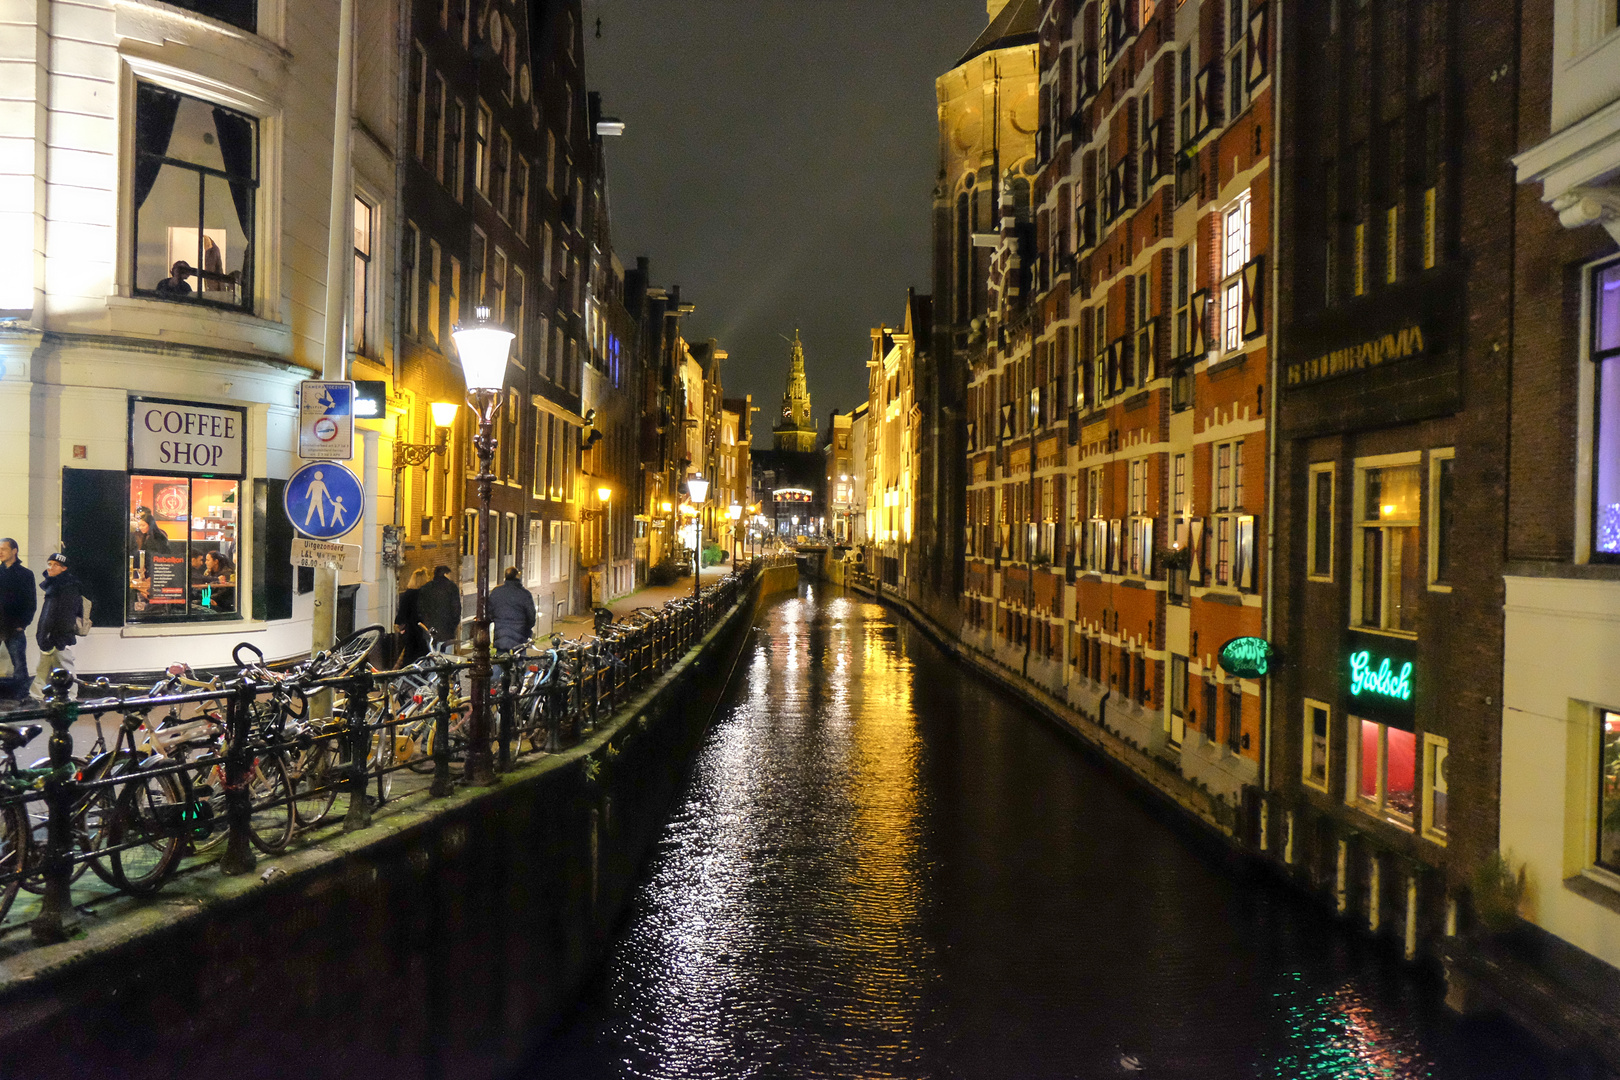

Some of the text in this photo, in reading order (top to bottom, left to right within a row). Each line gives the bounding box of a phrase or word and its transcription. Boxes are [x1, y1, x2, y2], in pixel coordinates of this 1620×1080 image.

[145, 409, 235, 439] COFFEE
[160, 440, 223, 467] SHOP
[304, 541, 344, 552] Uitgezonderd
[1349, 650, 1413, 701] Grolsch
